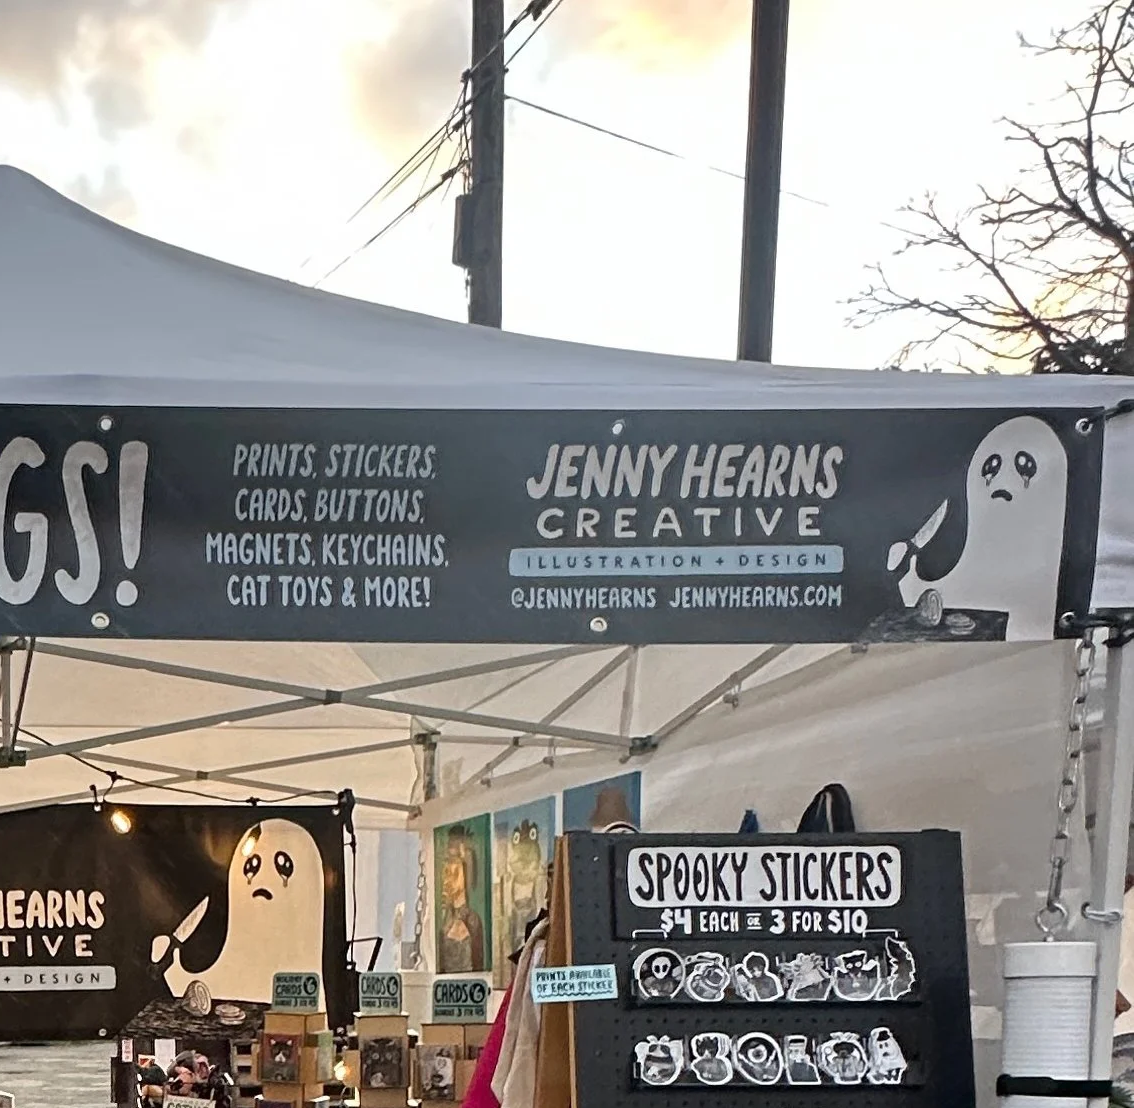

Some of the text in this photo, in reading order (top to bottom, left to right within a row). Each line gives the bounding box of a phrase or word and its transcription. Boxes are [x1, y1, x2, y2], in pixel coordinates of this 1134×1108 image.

[232, 443, 437, 480] PRINTS, STICKERS,
[526, 443, 844, 500] JENNY HEARNS
[234, 488, 424, 524] CARDS, BUTTONS,
[536, 506, 821, 539] CREATIVE
[205, 532, 450, 568] MAGNETS, KEYCHAINS,
[526, 554, 703, 570] ILLUSTRATION
[738, 553, 827, 568] DESIGN
[226, 575, 431, 608] CAT TOYS & MORE!
[511, 584, 843, 610] @JENNYHEARNS JENNYHEARNS.COM
[634, 851, 894, 902] SPOOKY STICKERS
[660, 908, 692, 935] $4
[699, 910, 739, 933] EACH
[769, 908, 785, 935] 3
[792, 910, 822, 933] FOR
[827, 908, 869, 934] $10
[24, 972, 102, 985] DESIGN
[361, 976, 385, 995] CARDS
[536, 970, 566, 982] PRINTS
[536, 980, 613, 993] OF EACH STICKER
[275, 984, 302, 995] CARDS
[434, 983, 468, 1003] CARDS
